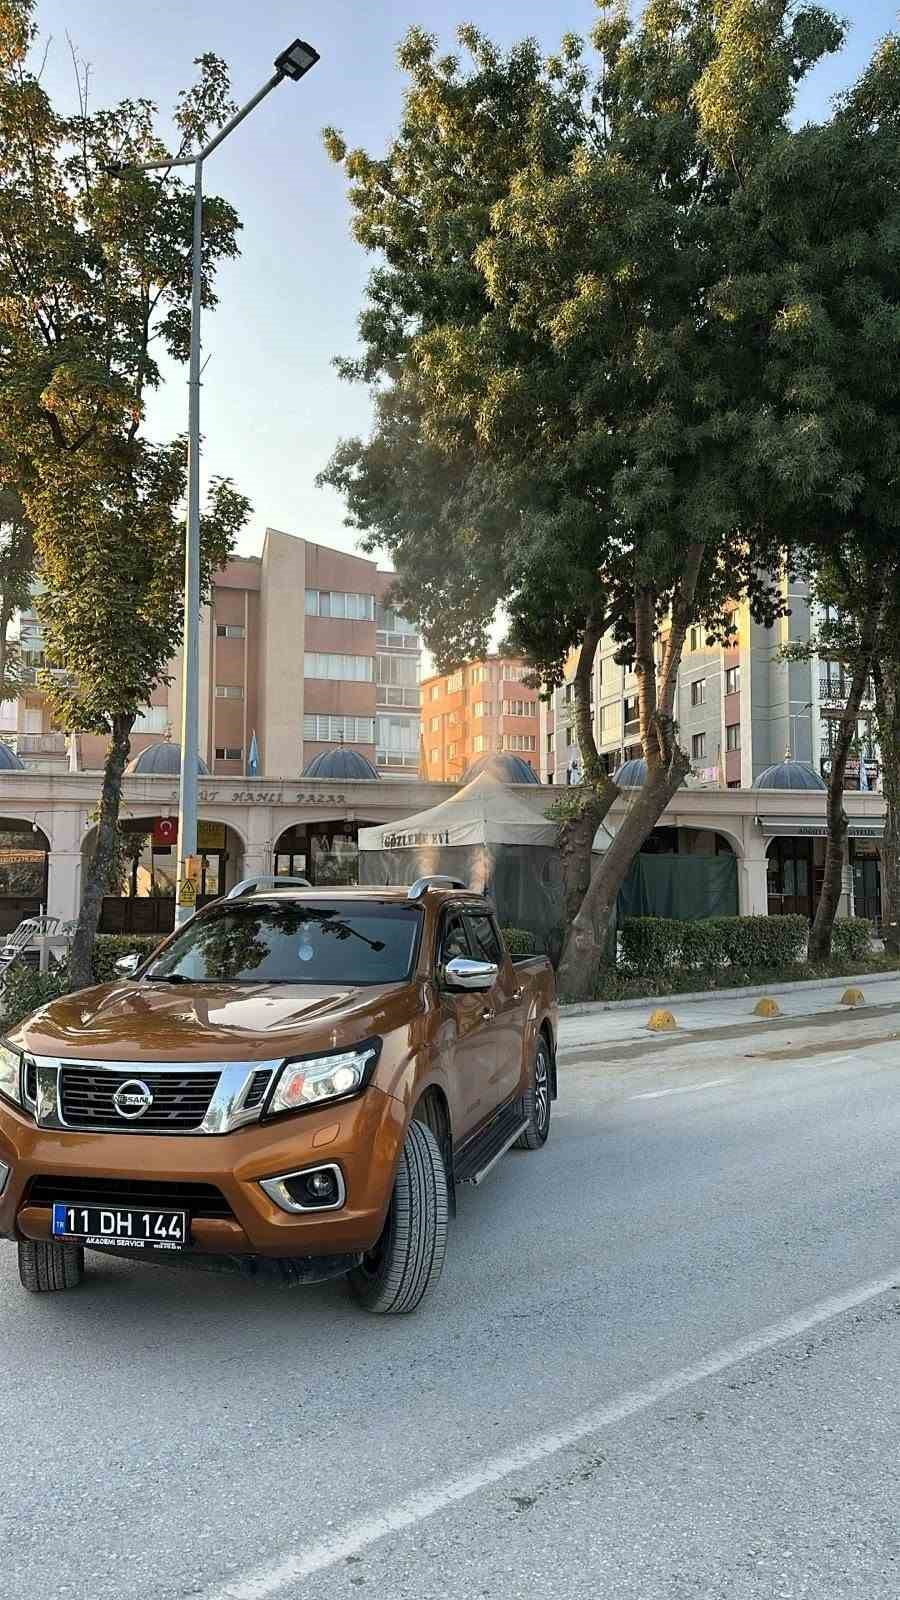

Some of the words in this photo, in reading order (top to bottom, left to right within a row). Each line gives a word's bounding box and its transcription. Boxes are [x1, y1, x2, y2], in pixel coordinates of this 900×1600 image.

[171, 791, 219, 801] SÜT
[112, 1094, 151, 1105] NISSAN
[68, 1209, 89, 1233] 11
[100, 1211, 132, 1236] DH
[142, 1214, 182, 1239] 144
[116, 1239, 145, 1248] SERVICE
